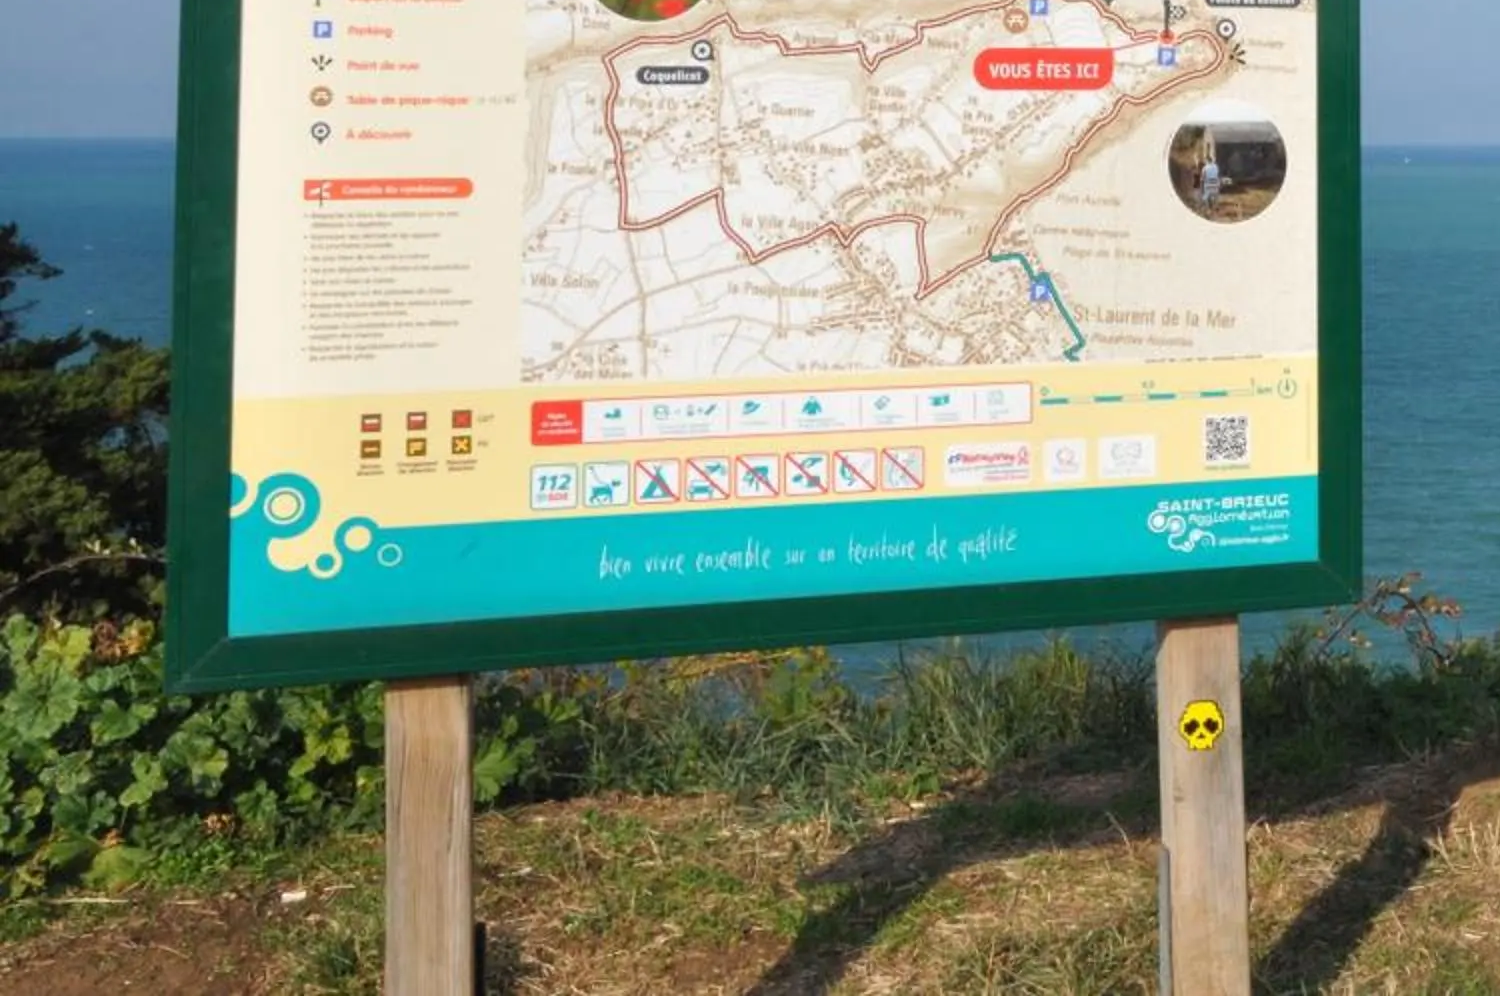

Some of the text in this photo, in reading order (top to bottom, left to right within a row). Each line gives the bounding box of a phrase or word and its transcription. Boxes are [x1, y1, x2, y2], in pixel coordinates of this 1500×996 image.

[643, 70, 702, 84] Coquelicot
[989, 57, 1099, 79] VOUS ÊTES ICI
[1161, 308, 1180, 326] de
[1186, 310, 1200, 327] la
[1207, 309, 1236, 329] Mer
[539, 474, 571, 491] 112
[1157, 493, 1289, 513] SAINT-BRIEUC
[599, 544, 631, 580] bien
[645, 552, 685, 576] vivre
[696, 535, 771, 574] ensemble
[785, 548, 805, 565] sur
[848, 530, 916, 565] territoire
[925, 522, 949, 564] de
